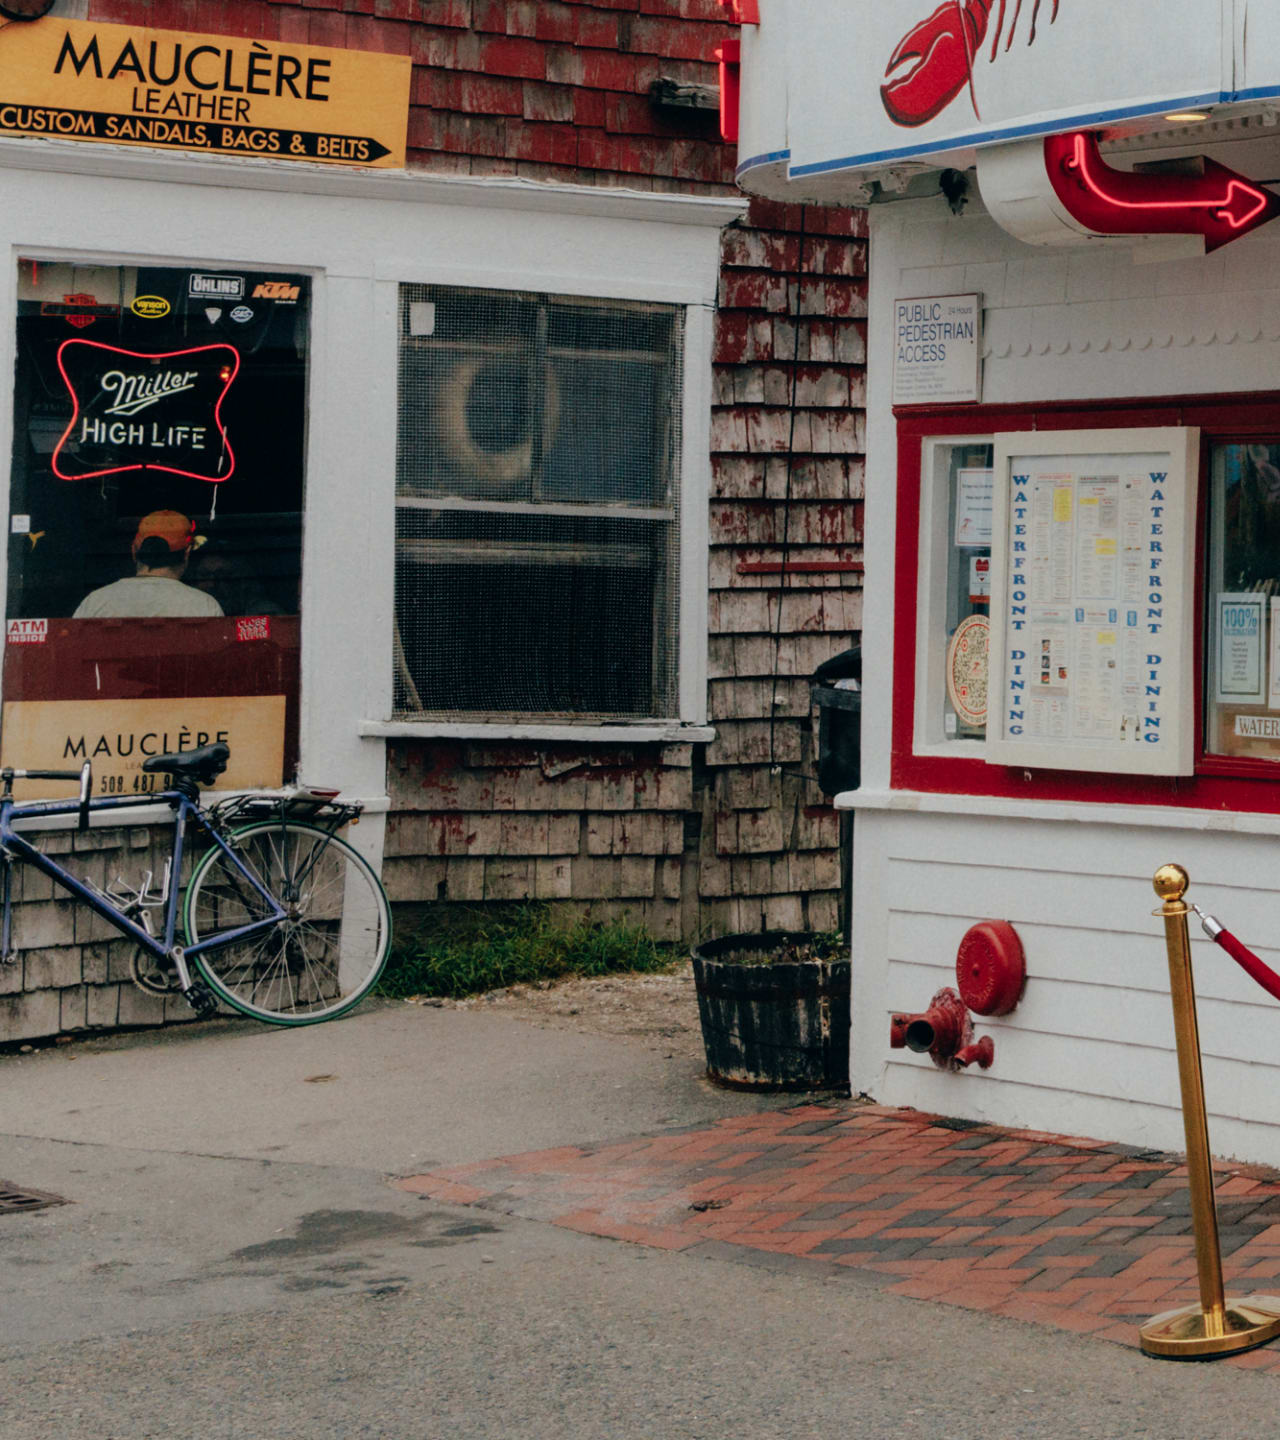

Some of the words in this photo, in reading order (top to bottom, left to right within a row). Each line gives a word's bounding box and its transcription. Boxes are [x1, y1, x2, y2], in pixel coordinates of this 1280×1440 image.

[53, 31, 332, 102] MAUCLÈRE
[132, 87, 251, 124] LEATHER
[0, 105, 97, 135] CUSTOM
[105, 116, 212, 148] SANDALS,
[221, 126, 279, 152] BAGS
[289, 133, 306, 155] &
[316, 136, 370, 161] BELTS
[251, 281, 301, 300] KTM
[898, 303, 941, 323] PUBLIC
[898, 322, 974, 342] PEDESTRIAN
[898, 343, 946, 363] ACCESS
[101, 370, 198, 408] Miller
[80, 417, 144, 445] HIGH
[151, 422, 207, 449] LIFE
[1012, 474, 1030, 631] WATERFRONT
[1147, 472, 1168, 635] WATERFRONT
[10, 620, 46, 633] ATM
[1223, 607, 1258, 628] 100%
[8, 634, 46, 644] INSIDE
[1009, 649, 1026, 736] DINING
[1143, 654, 1162, 744] DINING
